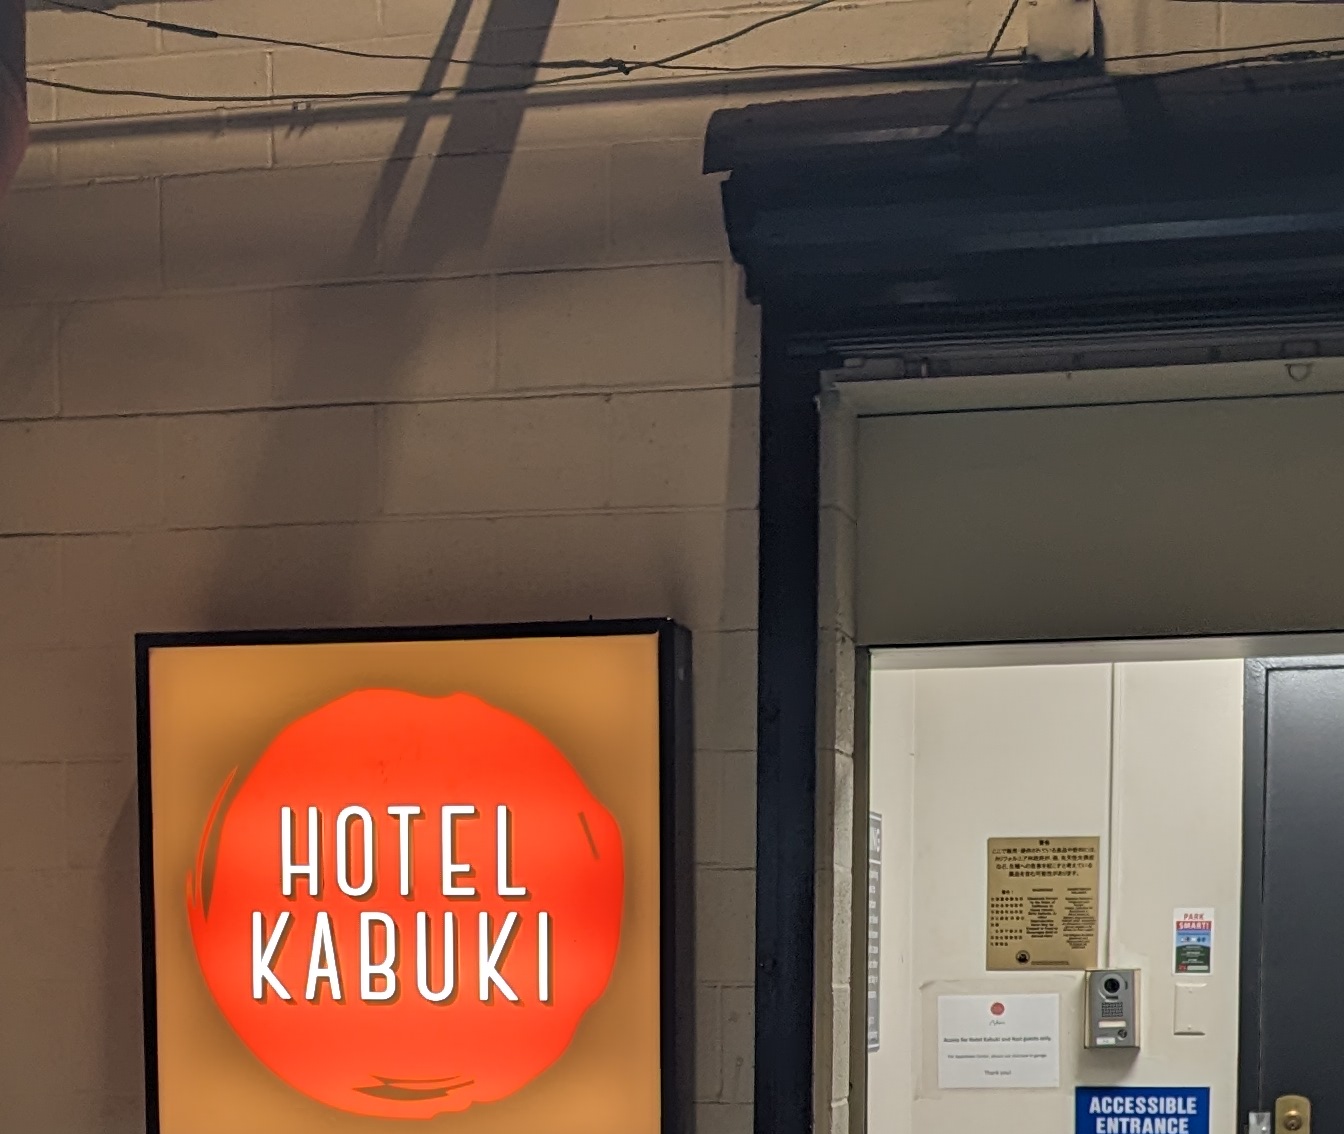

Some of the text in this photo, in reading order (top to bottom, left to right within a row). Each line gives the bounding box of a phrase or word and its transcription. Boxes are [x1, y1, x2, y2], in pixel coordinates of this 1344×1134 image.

[280, 805, 526, 896] HOTEL
[1179, 922, 1209, 930] SMART!
[252, 911, 549, 1002] KABUKI
[1089, 1096, 1197, 1114] ACCESSIBLE
[1096, 1117, 1189, 1134] ENTRANCE
